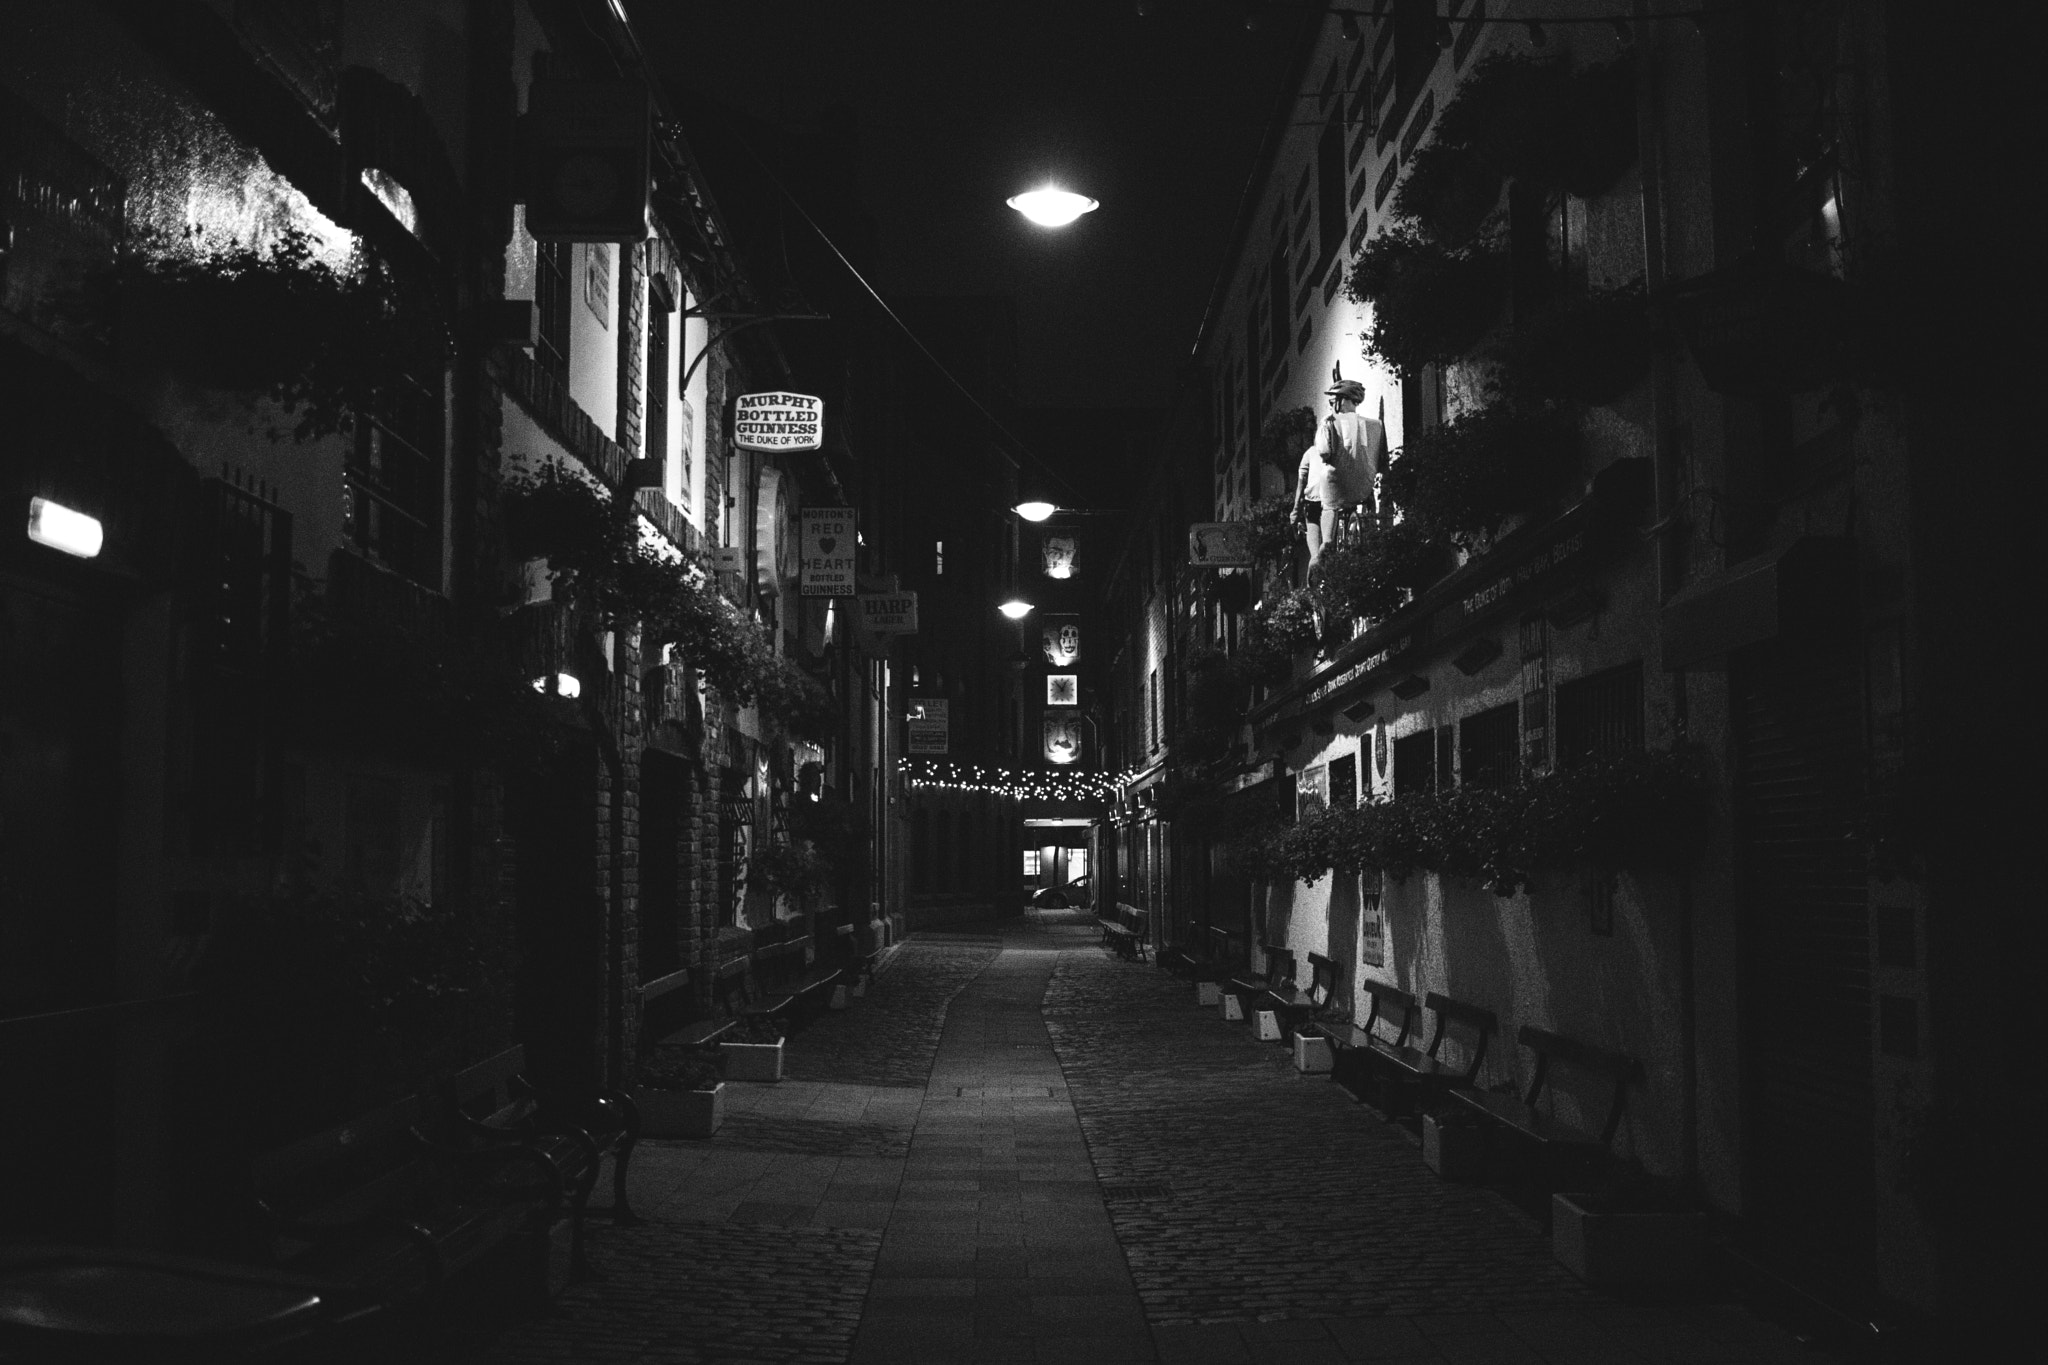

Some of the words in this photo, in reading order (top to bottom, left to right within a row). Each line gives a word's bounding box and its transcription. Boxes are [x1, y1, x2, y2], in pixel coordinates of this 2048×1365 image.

[740, 394, 818, 409] MURPHY
[737, 410, 818, 422] BOTTLED
[737, 422, 818, 434] GUINNESS
[739, 434, 755, 443] THE
[757, 435, 779, 445] DUKE
[780, 436, 792, 445] OF
[793, 435, 815, 444] YORK
[802, 510, 854, 519] MORTON'S
[811, 523, 844, 535] RED
[801, 558, 854, 570] HEART
[810, 574, 845, 582] BOTTLED
[802, 584, 853, 595] GUINNESS
[865, 599, 912, 615] HARP
